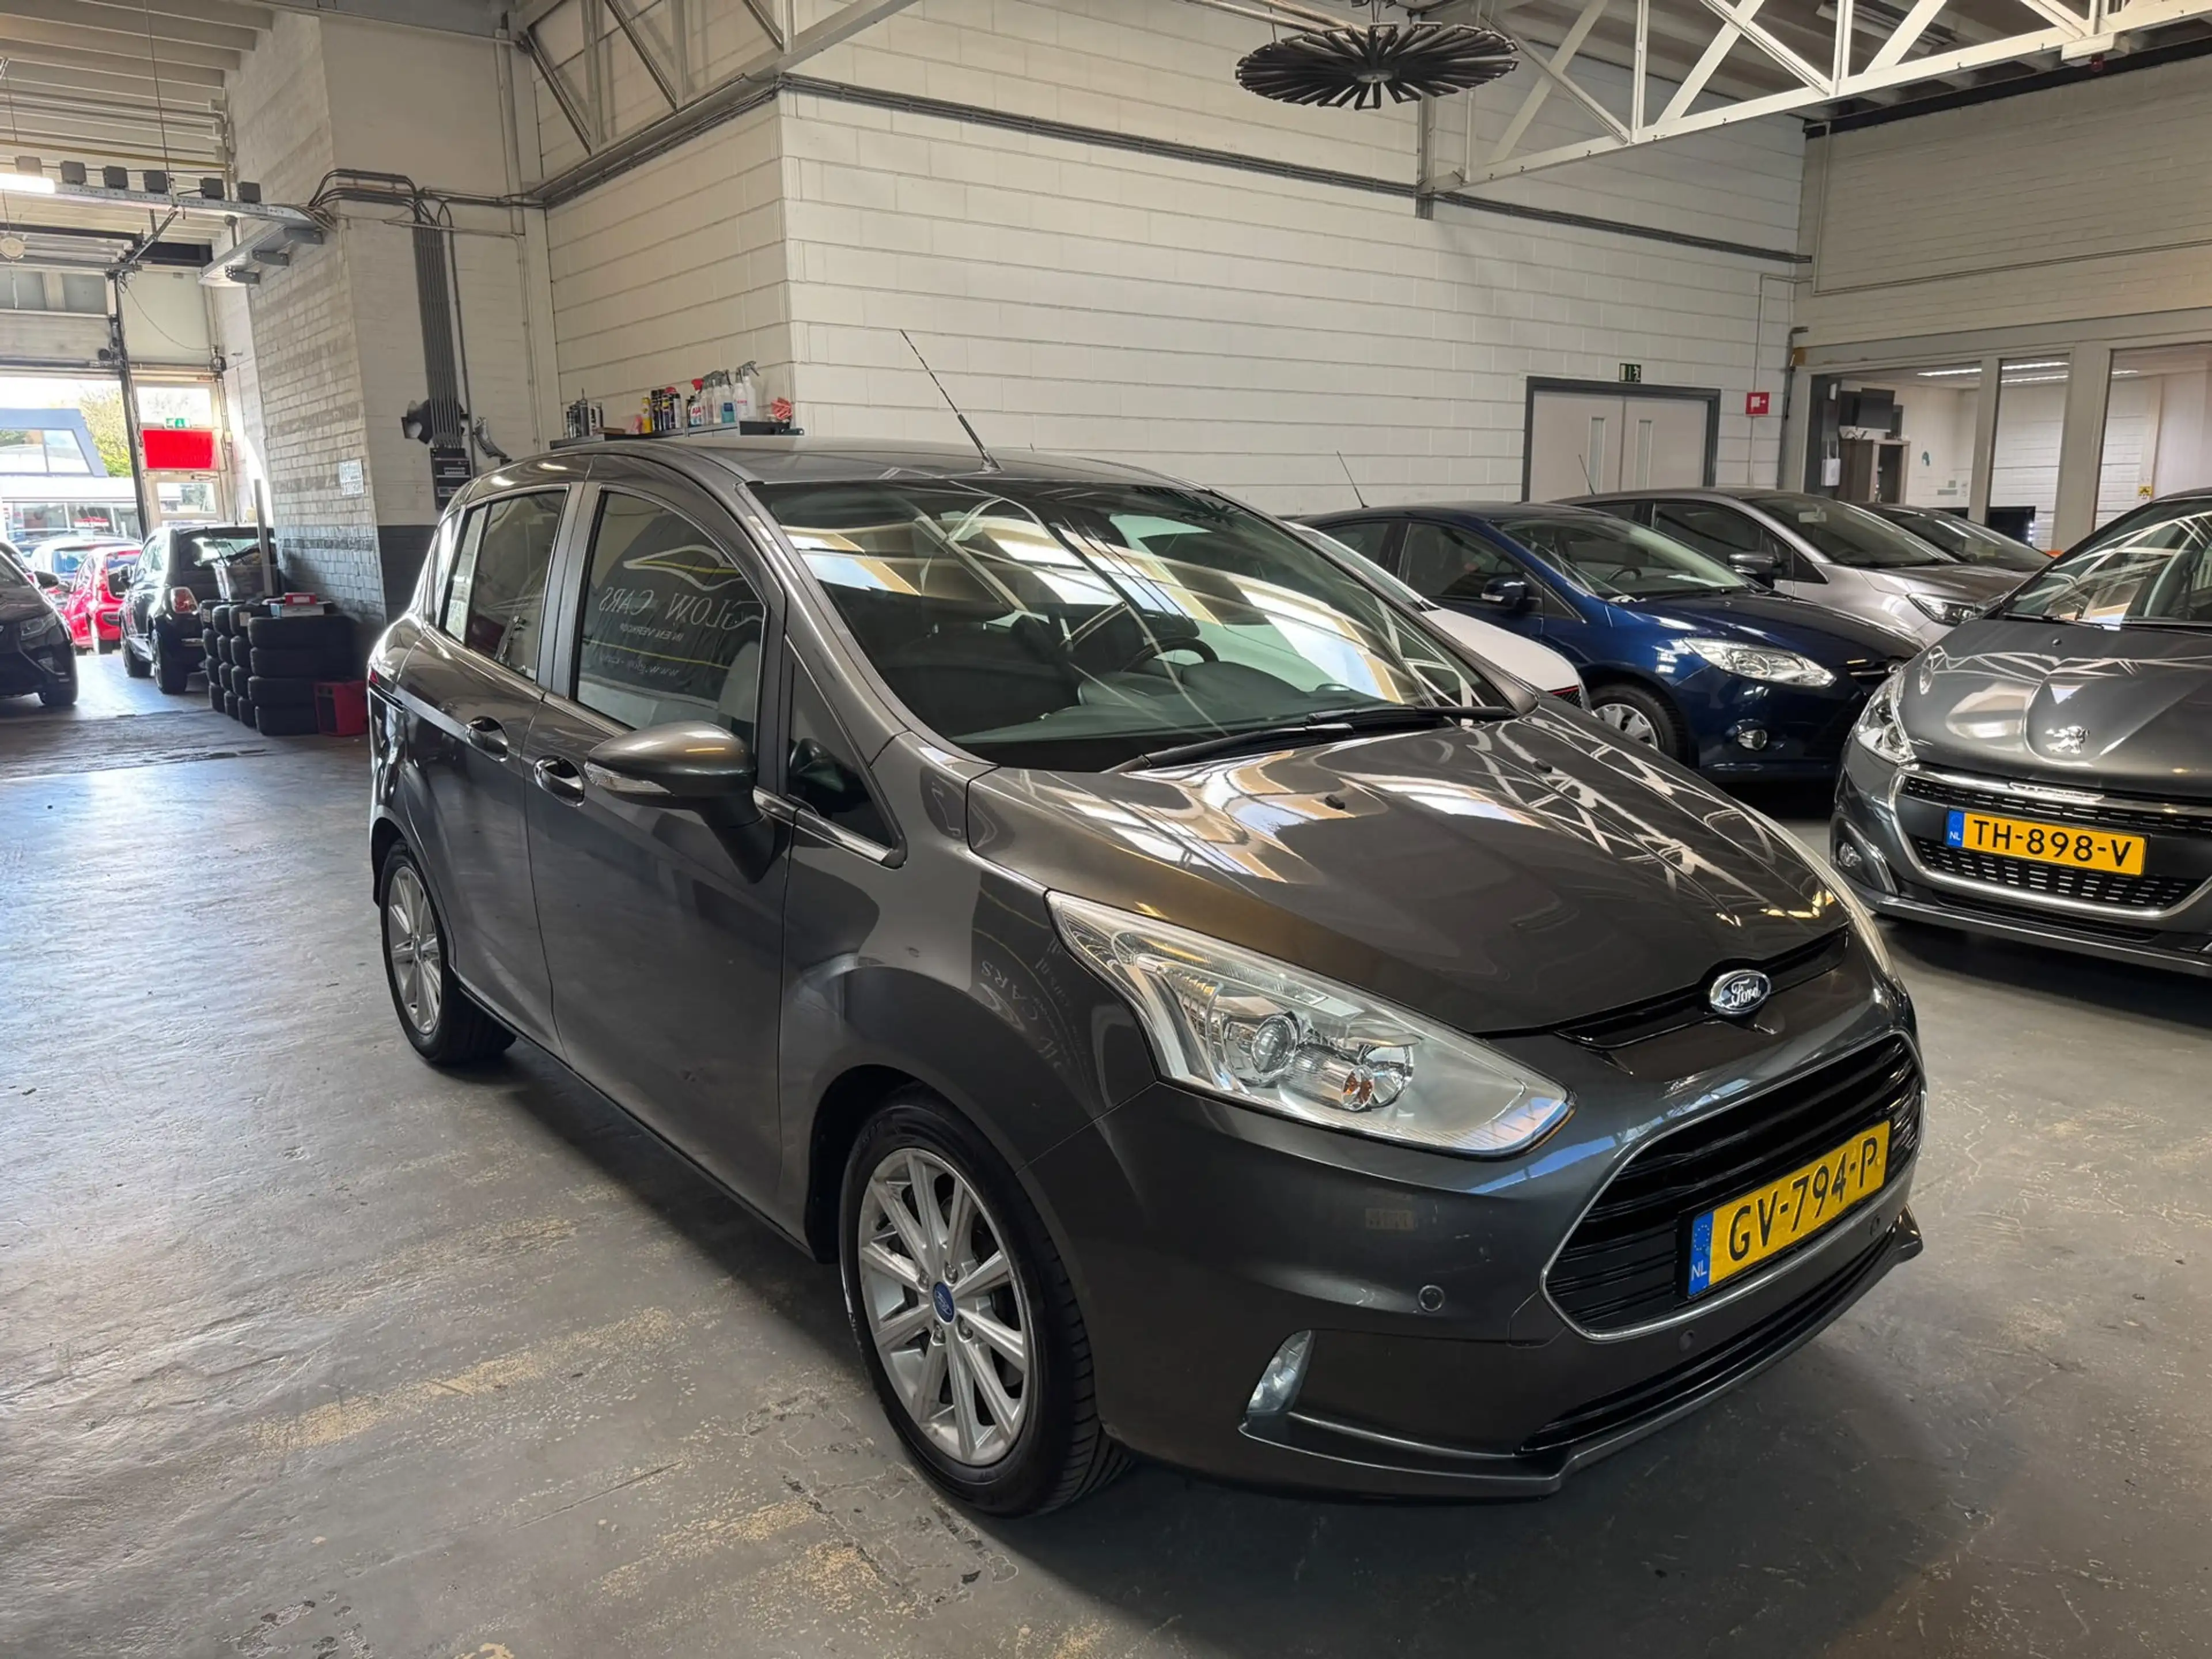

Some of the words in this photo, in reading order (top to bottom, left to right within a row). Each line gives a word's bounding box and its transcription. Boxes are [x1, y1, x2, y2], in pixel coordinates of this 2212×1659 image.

[1949, 831, 1961, 841] NL
[1973, 819, 2132, 867] TH-898-V
[1729, 978, 1762, 1007] Ford
[1729, 1136, 1878, 1262] GV-794-P
[1691, 1259, 1707, 1282] NL
